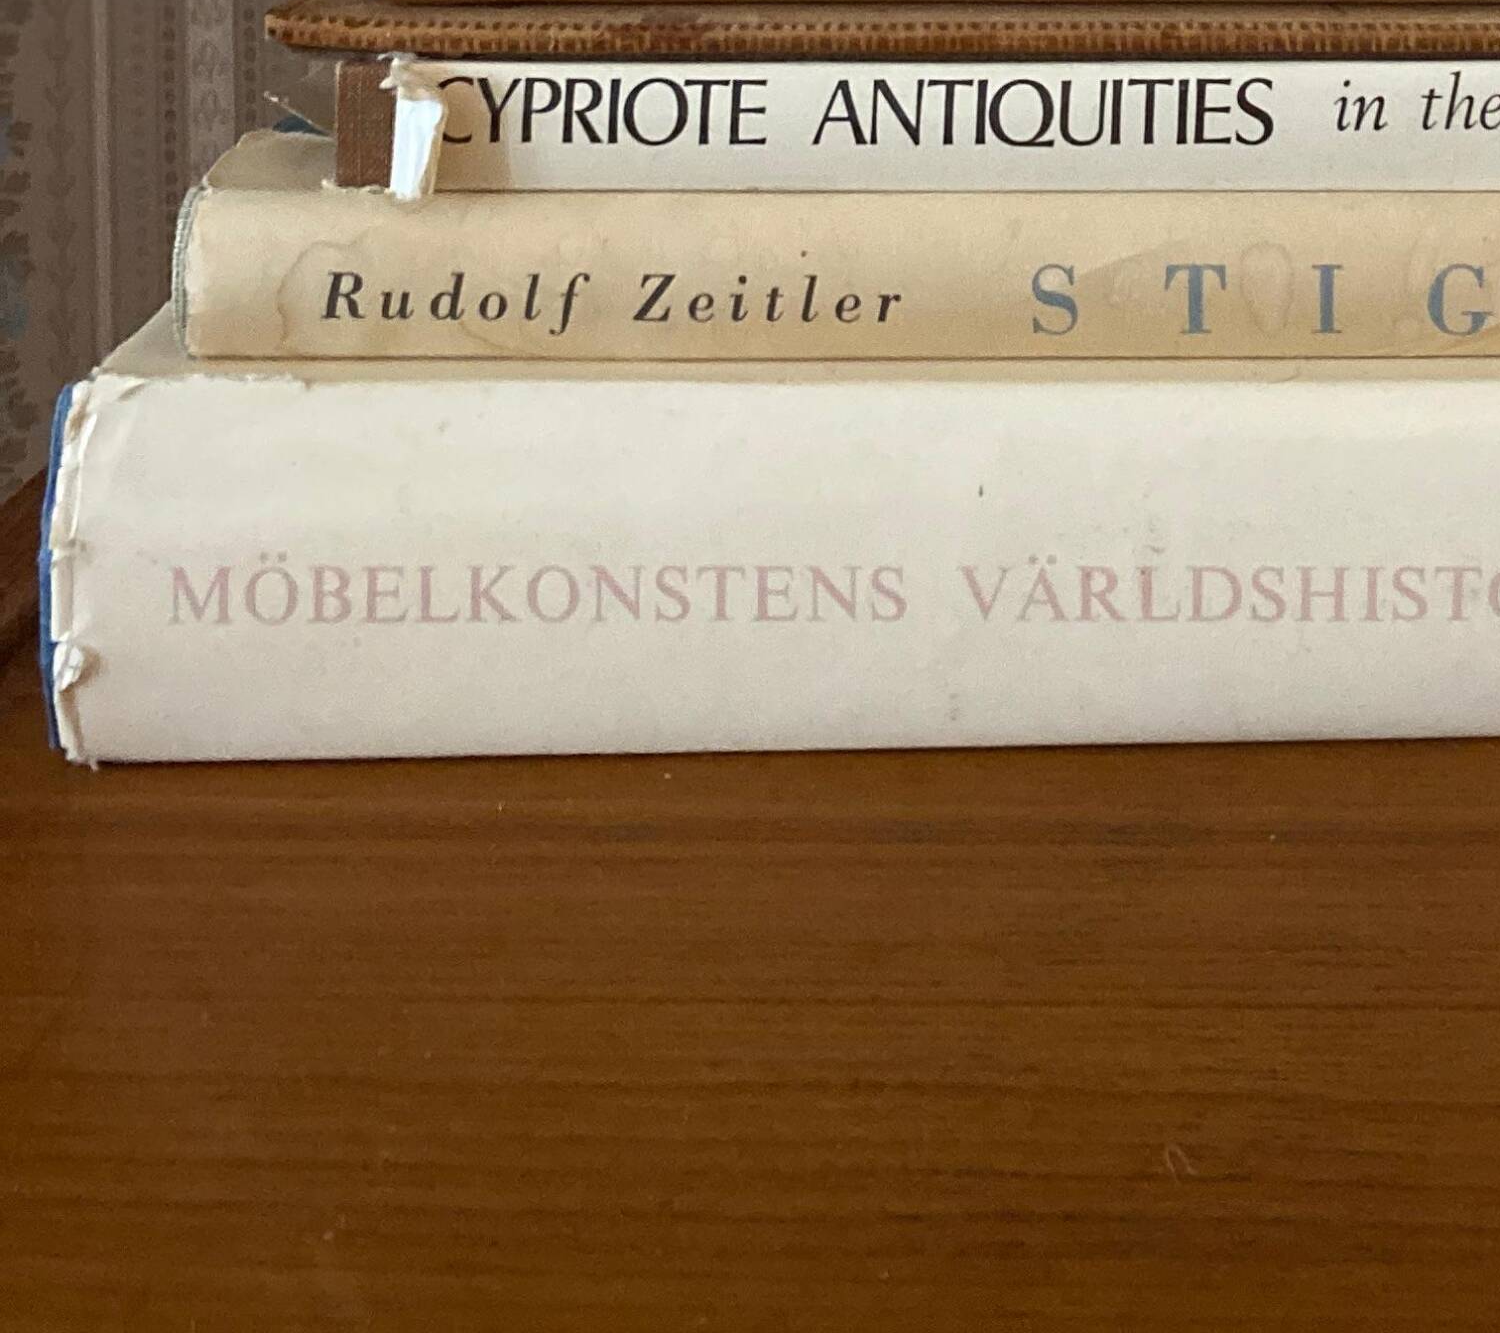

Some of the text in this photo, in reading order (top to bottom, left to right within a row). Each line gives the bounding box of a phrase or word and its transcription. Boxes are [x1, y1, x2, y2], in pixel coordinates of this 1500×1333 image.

[812, 77, 1274, 148] ANTIQUITIES
[1335, 78, 1388, 132] in
[321, 271, 903, 335] Rudolf Zeitler
[1031, 263, 1494, 336] STIG
[170, 552, 908, 627] MÖBELKONSTENS
